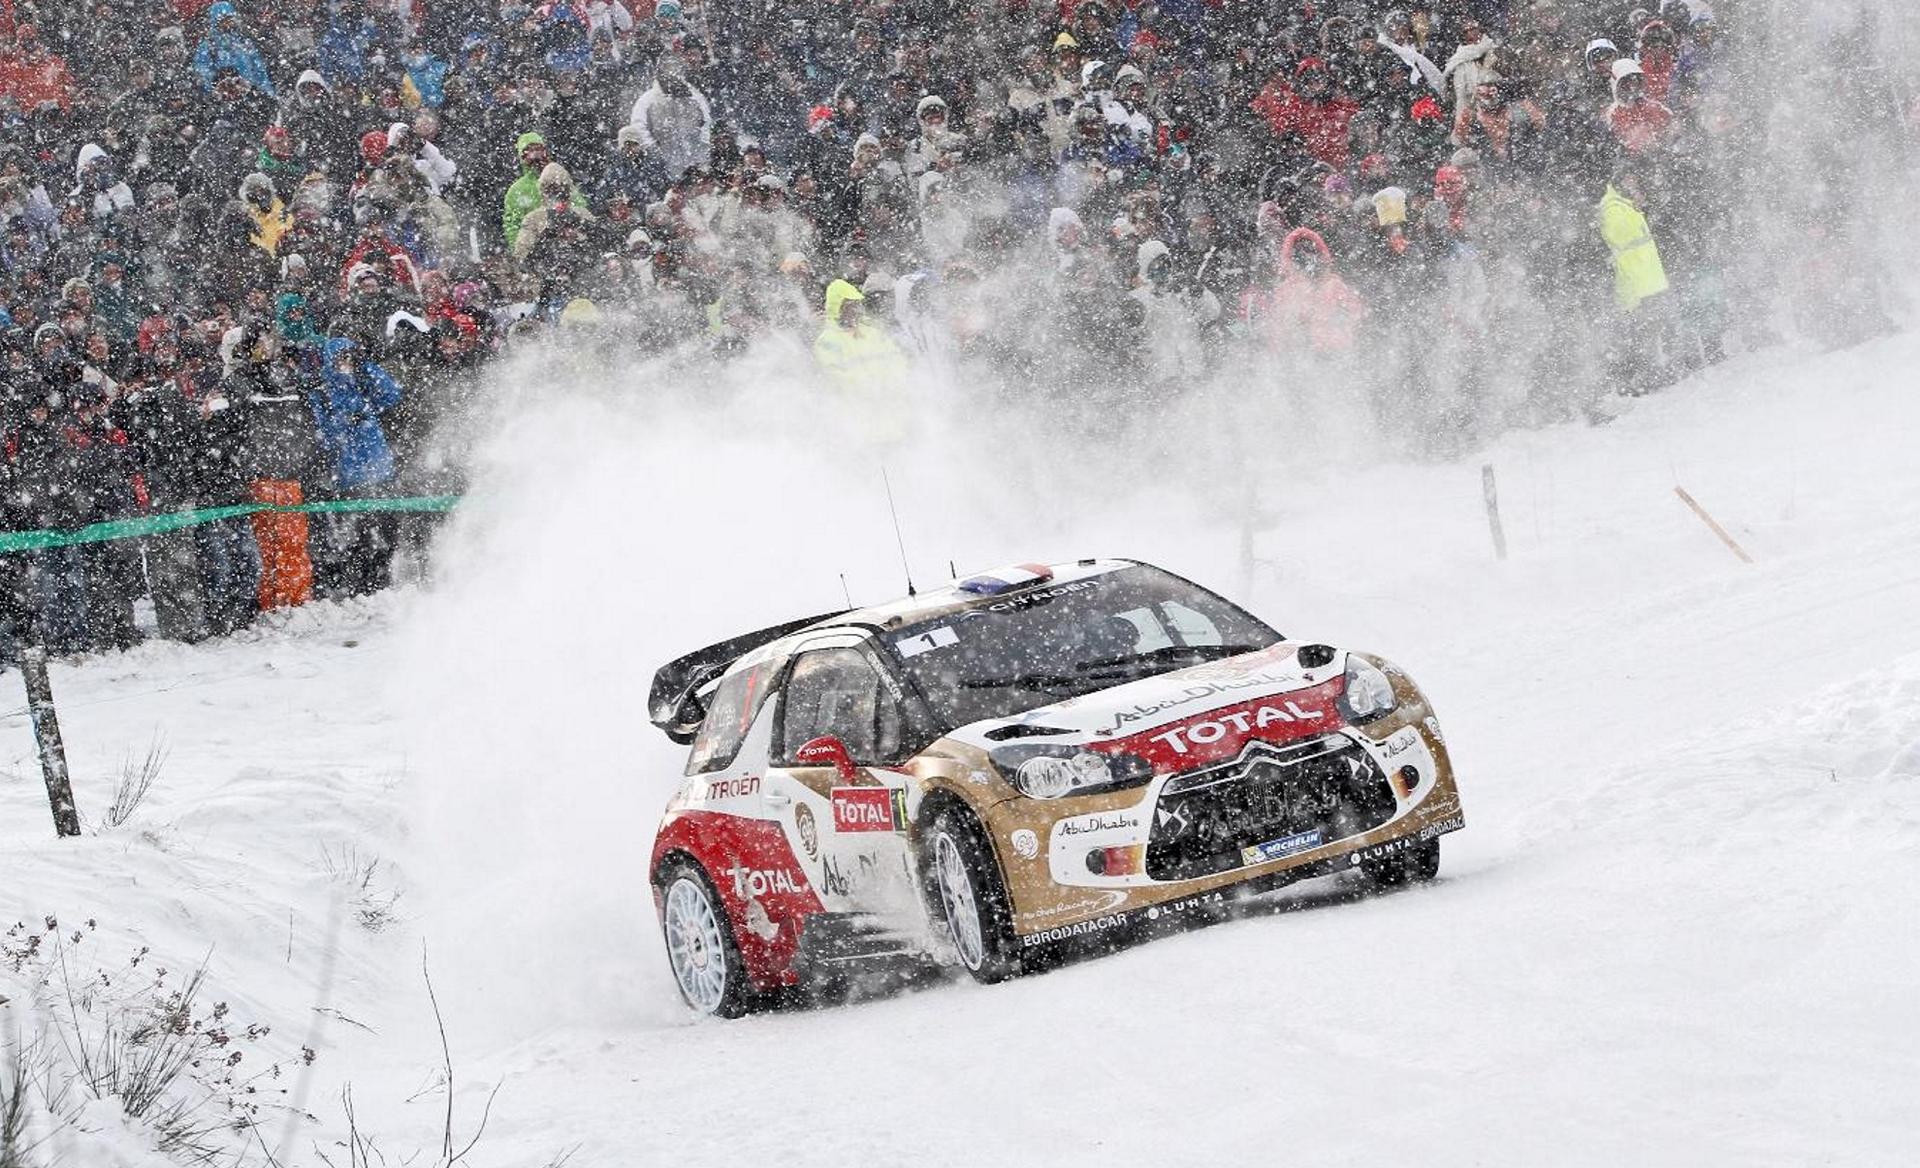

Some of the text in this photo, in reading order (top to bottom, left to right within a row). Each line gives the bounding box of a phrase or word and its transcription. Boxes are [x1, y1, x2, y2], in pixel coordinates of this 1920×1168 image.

[920, 633, 937, 648] 1
[1150, 701, 1324, 754] TOTAL
[804, 745, 837, 757] TOTAL
[834, 798, 891, 823] TOTAL
[1265, 832, 1319, 855] MICHELIN
[1363, 838, 1413, 862] LUHTA
[726, 866, 802, 900] TOTAL
[1162, 892, 1224, 915] LUHTA
[1022, 912, 1128, 947] EURODATACAR
